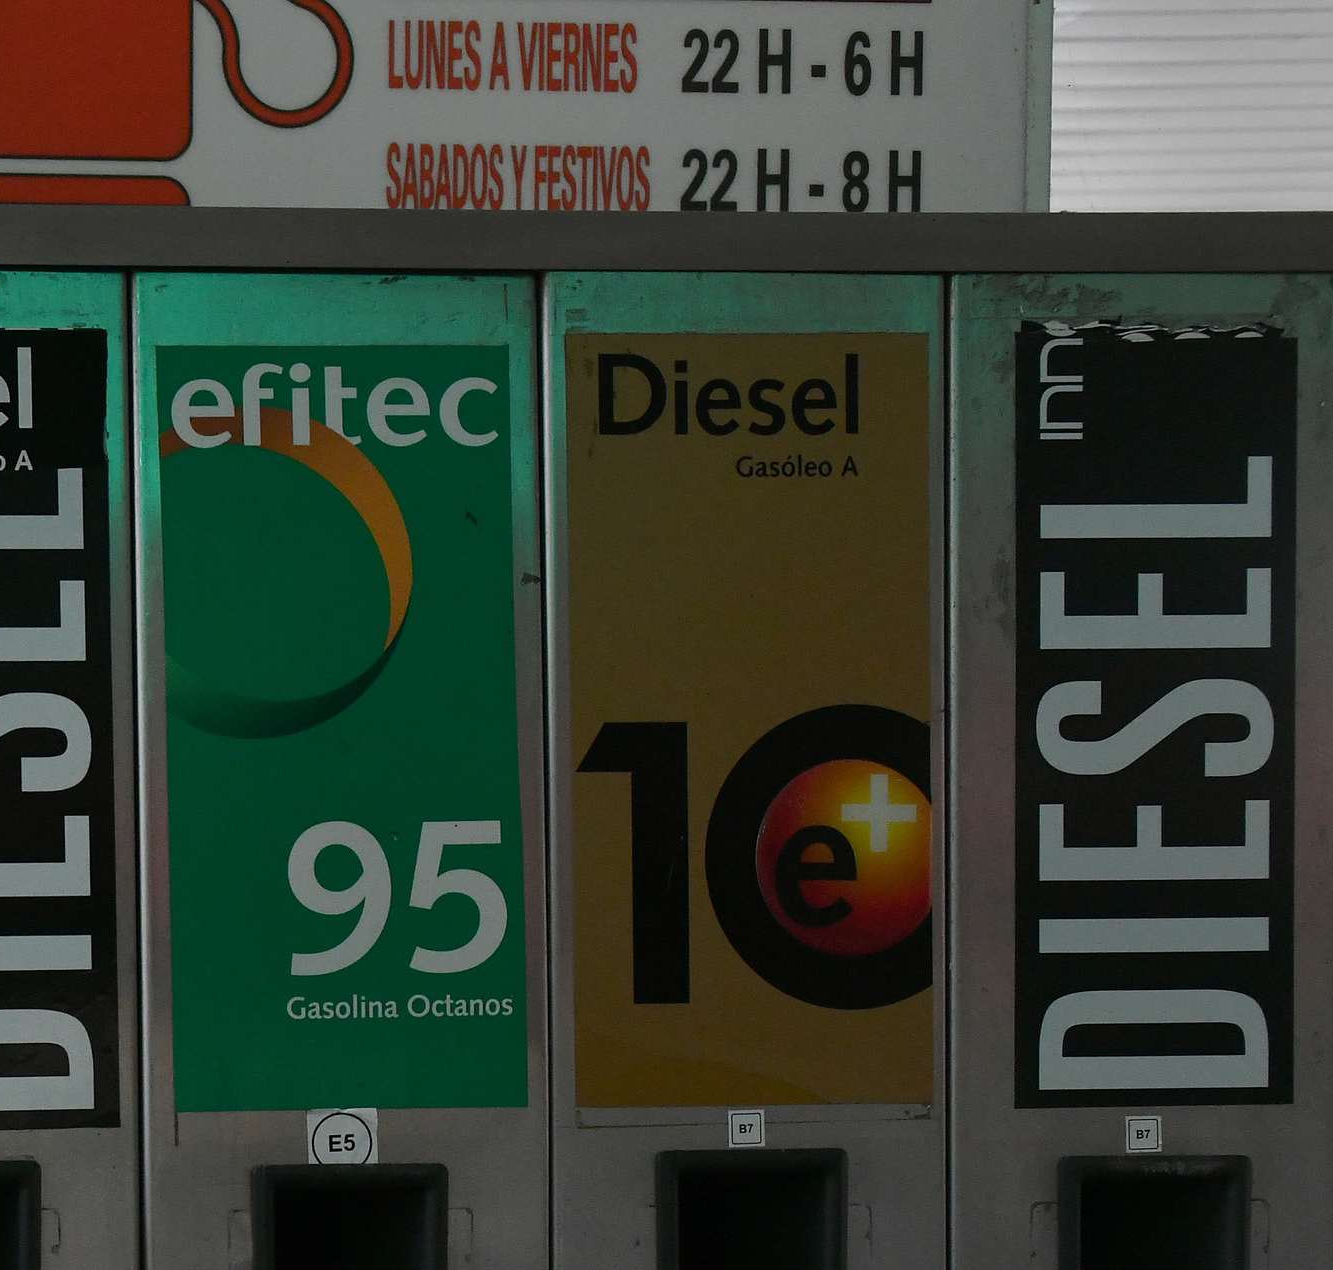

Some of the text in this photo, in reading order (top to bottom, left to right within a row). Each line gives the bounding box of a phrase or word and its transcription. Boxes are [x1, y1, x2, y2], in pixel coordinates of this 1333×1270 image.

[388, 20, 481, 90] LUNES
[489, 22, 510, 90] A
[517, 22, 637, 93] VIERNES
[681, 28, 739, 94] 22
[758, 28, 792, 95] H
[844, 31, 872, 97] 6
[890, 30, 924, 97] H
[386, 143, 503, 211] SABADOS
[511, 145, 528, 211] Y
[534, 145, 651, 212] FESTIVOS
[680, 148, 738, 213] 22
[757, 148, 790, 213] H
[842, 150, 870, 213] 8
[888, 150, 922, 213] H
[171, 362, 500, 449] efitec
[596, 353, 861, 437] Diesel
[15, 450, 34, 471] A
[735, 454, 860, 479] Gasóleo A
[1036, 455, 1275, 1091] DIESEL
[286, 819, 509, 977] 95
[286, 993, 514, 1022] Gasolina Octanos
[328, 1132, 357, 1154] E5
[737, 1122, 755, 1136] B7
[1135, 1128, 1151, 1140] B7
